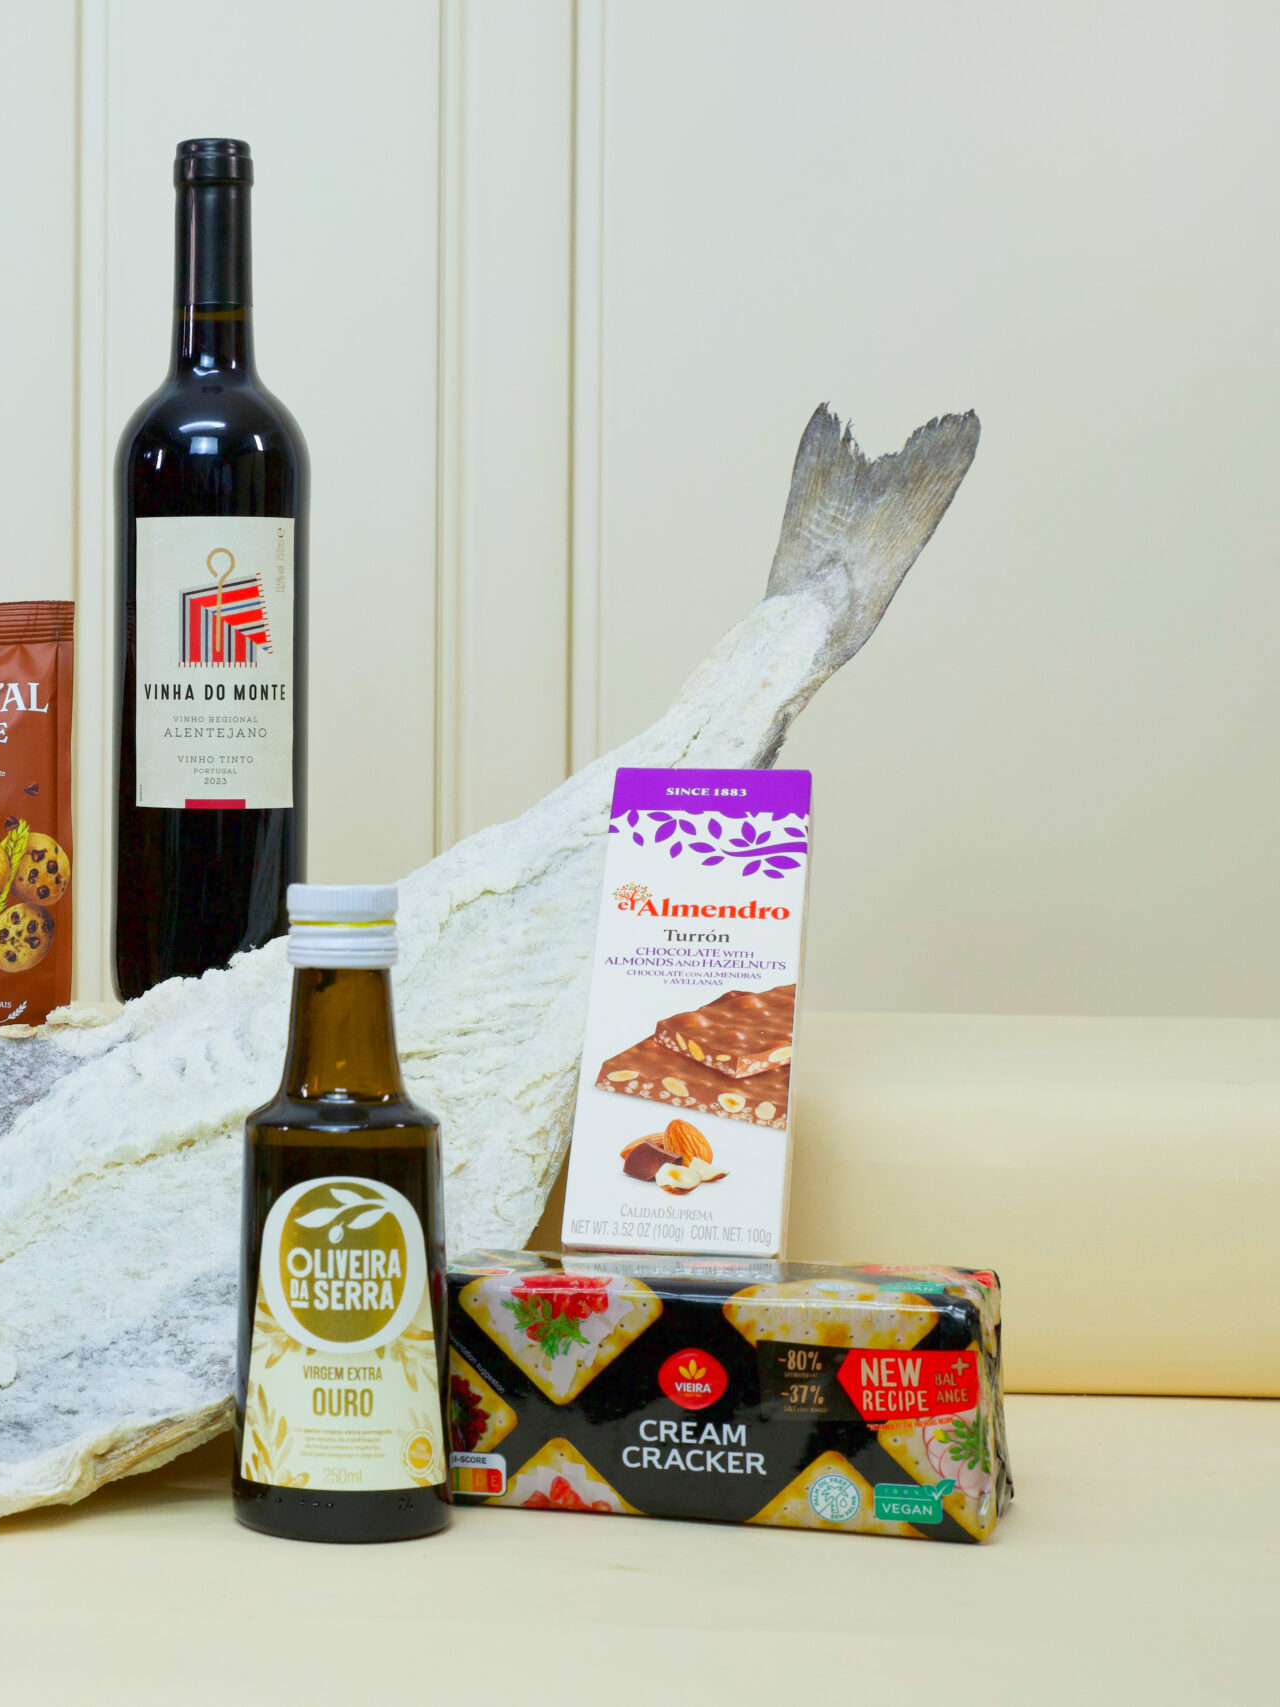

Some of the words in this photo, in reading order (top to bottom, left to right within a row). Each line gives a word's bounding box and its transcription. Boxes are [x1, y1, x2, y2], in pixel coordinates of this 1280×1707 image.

[144, 684, 195, 700] VINHA
[204, 684, 226, 701] DO
[233, 684, 286, 701] MONTE
[164, 728, 267, 738] ALENTEJANO
[177, 756, 215, 764] VINHO
[219, 756, 254, 764] TINTO
[204, 777, 227, 785] 2023
[666, 787, 710, 796] SINCE
[713, 788, 748, 797] 1883
[637, 897, 790, 920] Almendro
[664, 929, 730, 943] Turrón
[635, 947, 721, 958] CHOCOLATE
[722, 950, 754, 959] WITH
[604, 957, 674, 967] ALMONDS
[675, 960, 700, 968] AND
[702, 959, 787, 971] HAZELNUTS
[626, 969, 685, 977] CHOCOLATE
[703, 971, 762, 979] ALMENDRAS
[669, 978, 723, 986] AVELLANAS
[620, 1204, 665, 1219] CALIDAD
[665, 1206, 713, 1221] SUPREMA
[571, 1219, 591, 1234] NET
[592, 1220, 609, 1236] WT.
[612, 1222, 633, 1237] 3.52
[636, 1223, 651, 1238] OZ
[652, 1223, 684, 1242] (100g)
[691, 1225, 720, 1241] CONT.
[722, 1227, 744, 1242] NET.
[748, 1228, 772, 1246] 100g
[287, 1247, 402, 1279] OLIVEIRA
[290, 1279, 309, 1300] DA
[313, 1280, 395, 1310] SERRA
[777, 1349, 823, 1371] -80%
[302, 1365, 344, 1381] VIRGEM
[347, 1366, 383, 1381] EXTRA
[860, 1357, 922, 1387] NEW
[935, 1372, 957, 1387] BAL
[674, 1382, 712, 1393] VIEIRA
[780, 1384, 825, 1405] -37%
[312, 1388, 374, 1417] OURO
[862, 1389, 929, 1412] RECIPE
[936, 1388, 969, 1404] ANCE
[639, 1419, 747, 1447] CREAM
[452, 1455, 488, 1465] I-SCORE
[622, 1446, 767, 1475] CRACKER
[323, 1467, 363, 1484] 250ml
[881, 1503, 933, 1516] VEGAN
